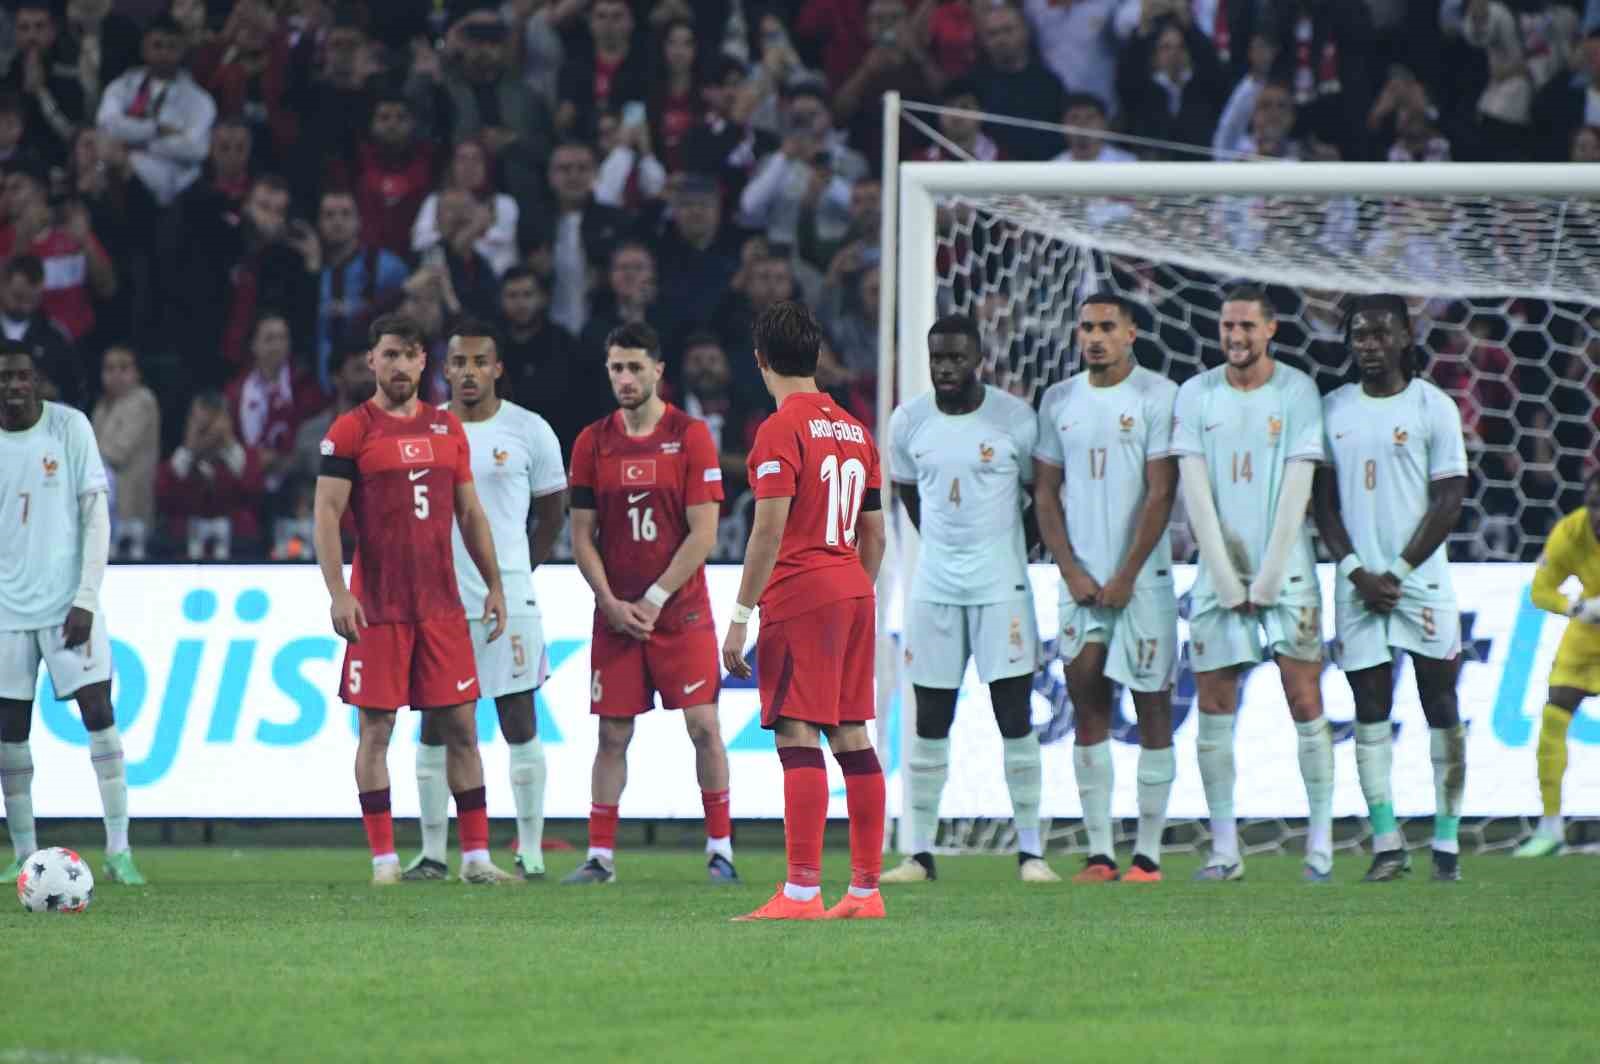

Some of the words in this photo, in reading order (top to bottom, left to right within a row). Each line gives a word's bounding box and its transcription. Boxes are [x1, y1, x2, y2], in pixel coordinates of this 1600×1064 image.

[1089, 448, 1107, 480] 17
[1231, 451, 1253, 484] 14
[1364, 458, 1377, 491] 8
[17, 492, 31, 524] 7
[413, 485, 429, 520] 5
[820, 454, 866, 546] 10
[948, 477, 962, 508] 4
[627, 507, 657, 542] 16
[510, 634, 525, 669] 5
[1136, 638, 1158, 670] 17
[349, 659, 363, 695] 5
